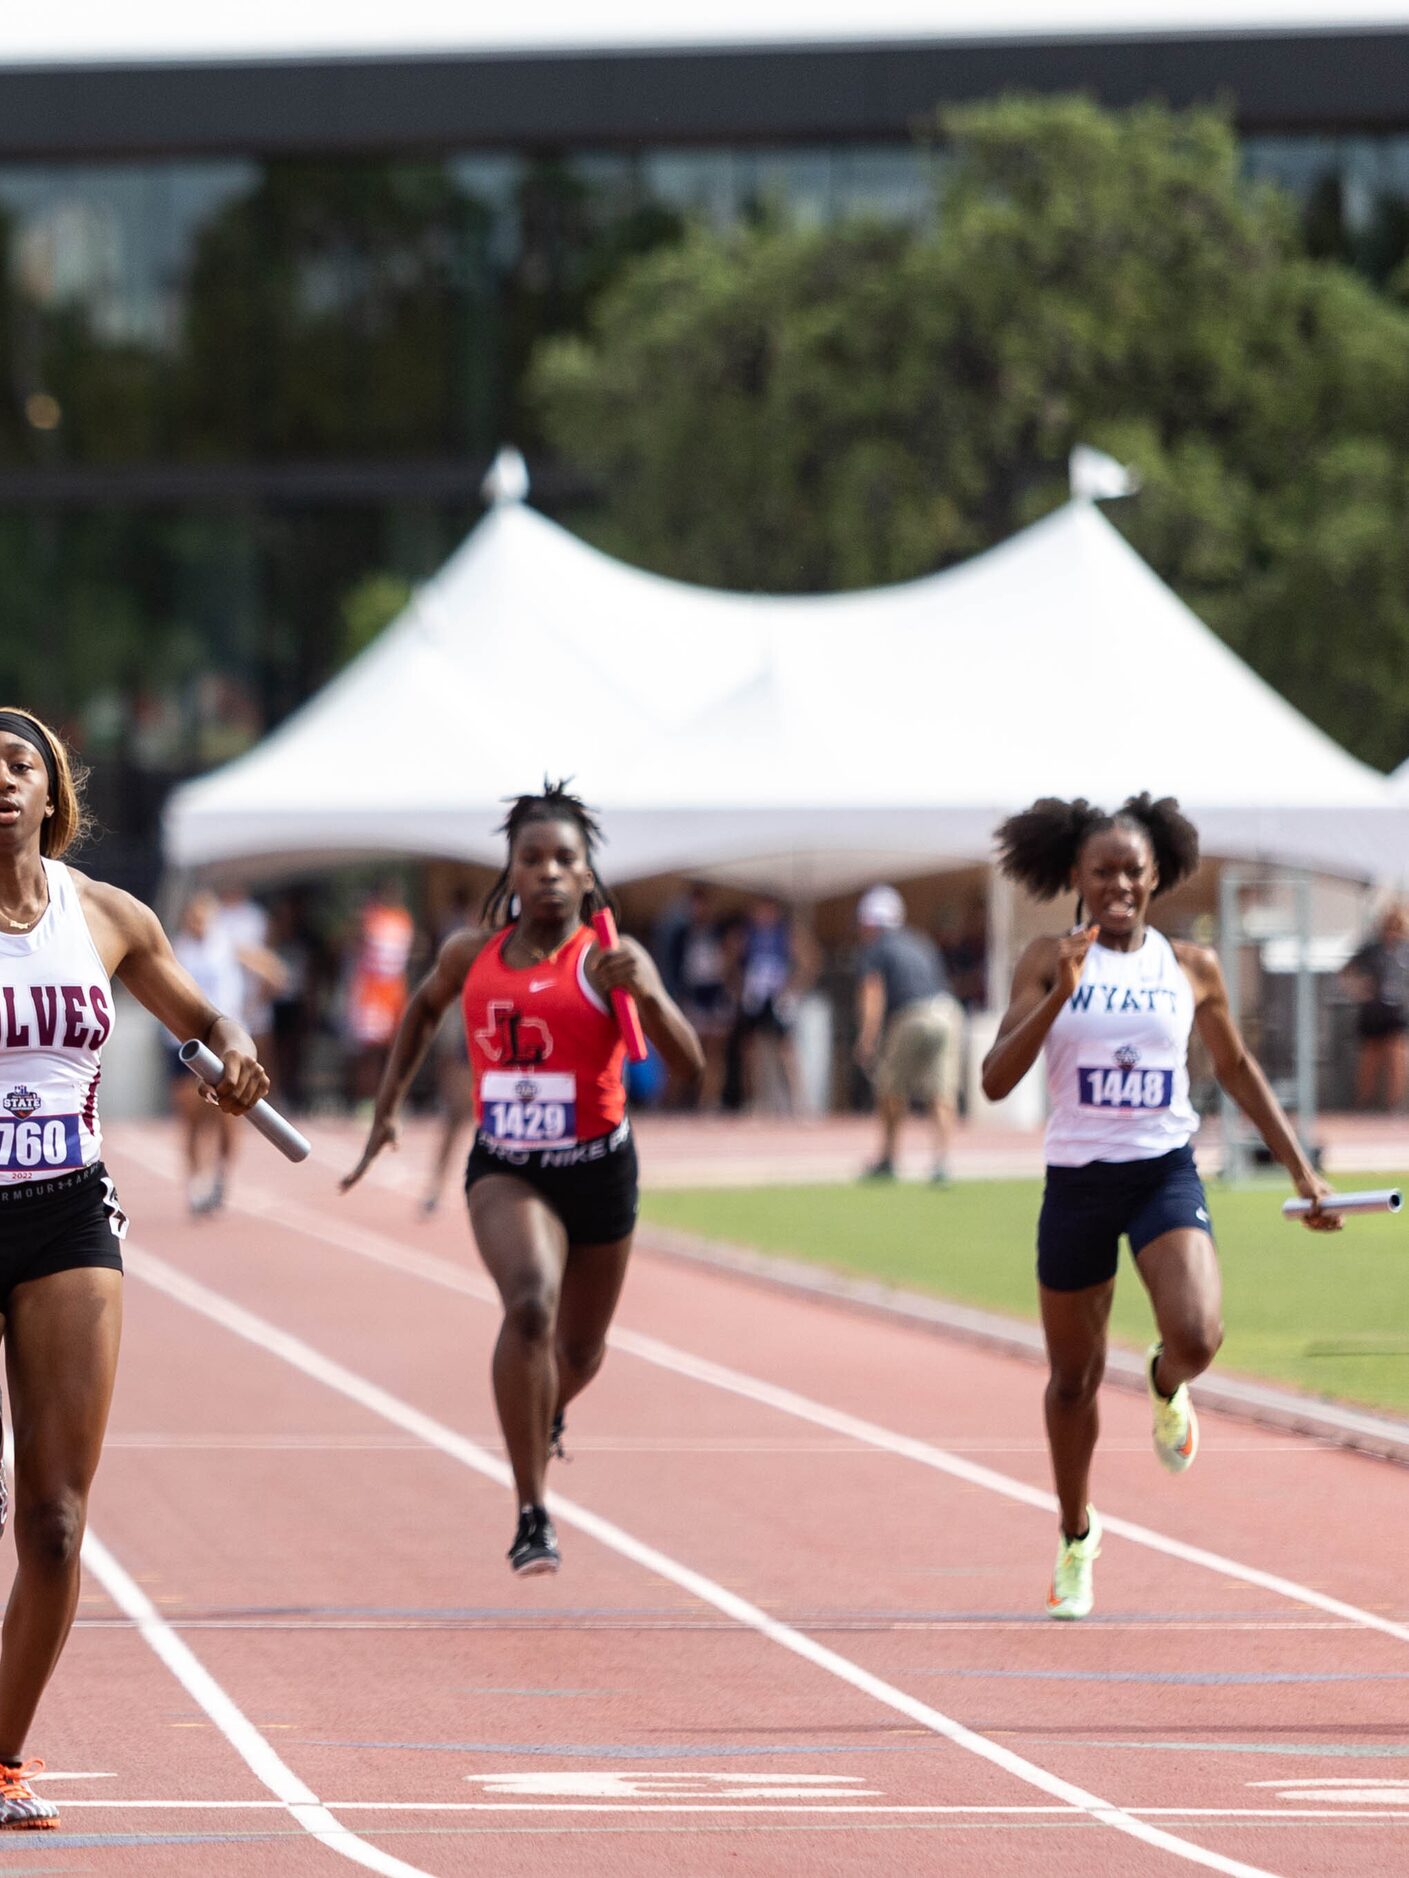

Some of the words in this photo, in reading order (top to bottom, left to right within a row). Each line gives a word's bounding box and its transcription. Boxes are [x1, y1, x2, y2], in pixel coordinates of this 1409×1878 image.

[1069, 984, 1177, 1014] WYATT
[3, 1097, 41, 1109] STATE
[1086, 1069, 1165, 1109] 1448
[490, 1102, 567, 1140] 1429
[541, 1137, 608, 1168] NIKE
[11, 1172, 33, 1180] 2022
